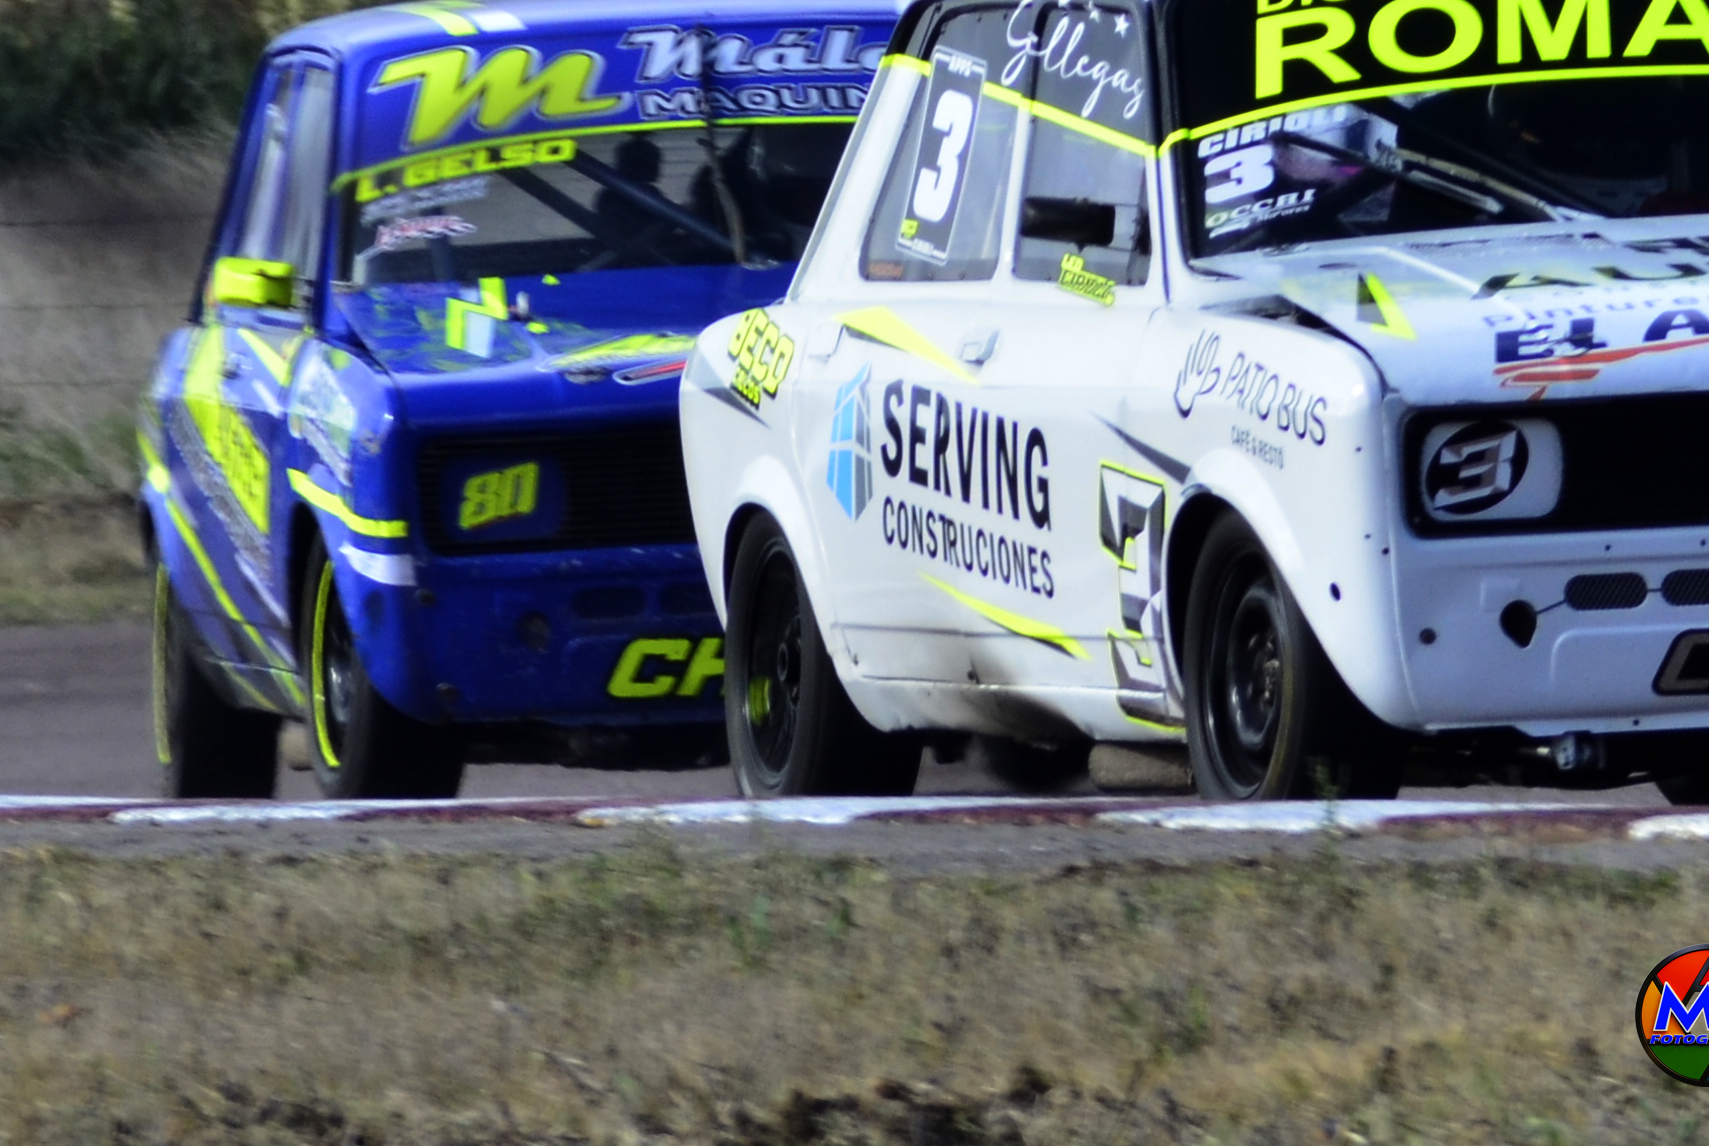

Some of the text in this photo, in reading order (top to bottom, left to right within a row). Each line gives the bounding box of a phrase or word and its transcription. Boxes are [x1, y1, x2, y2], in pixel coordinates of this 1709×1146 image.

[402, 138, 578, 188] GELSO
[913, 89, 974, 223] 3
[1204, 144, 1276, 204] 3
[1220, 352, 1328, 446] PATIO BUS
[458, 461, 540, 529] 80
[880, 378, 1052, 533] SERVING
[1434, 429, 1518, 510] 3
[882, 495, 1054, 599] CONSTRUCIONES
